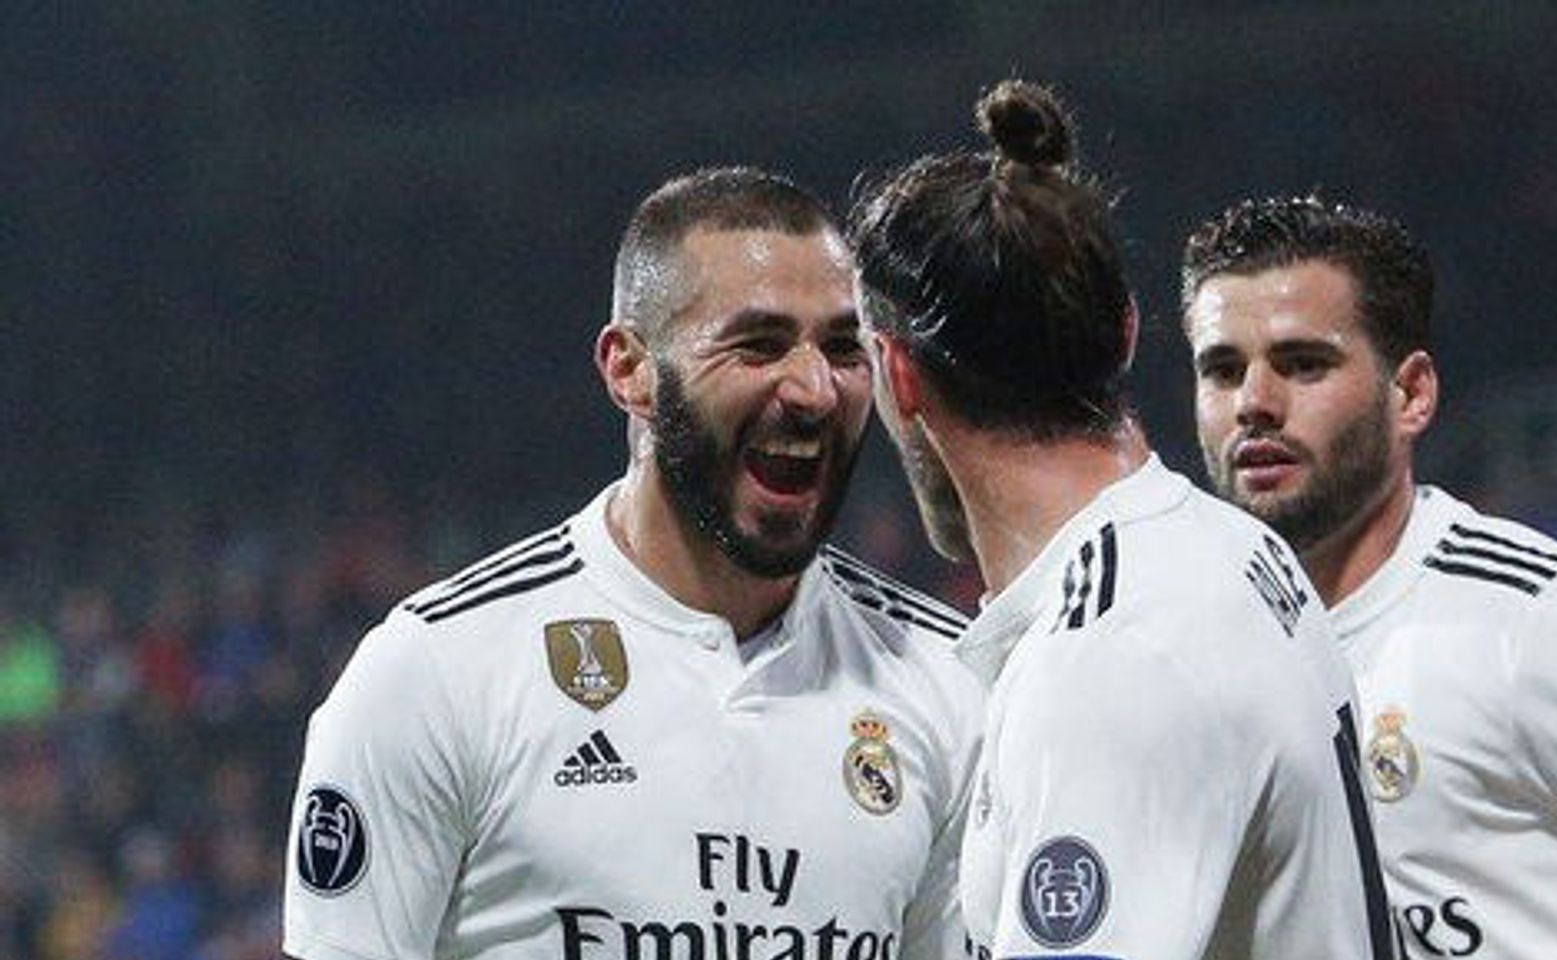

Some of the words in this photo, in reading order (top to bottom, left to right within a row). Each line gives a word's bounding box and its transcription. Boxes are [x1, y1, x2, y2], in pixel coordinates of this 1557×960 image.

[554, 766, 638, 787] adidas
[697, 832, 800, 907] Fly
[1045, 891, 1079, 917] 13
